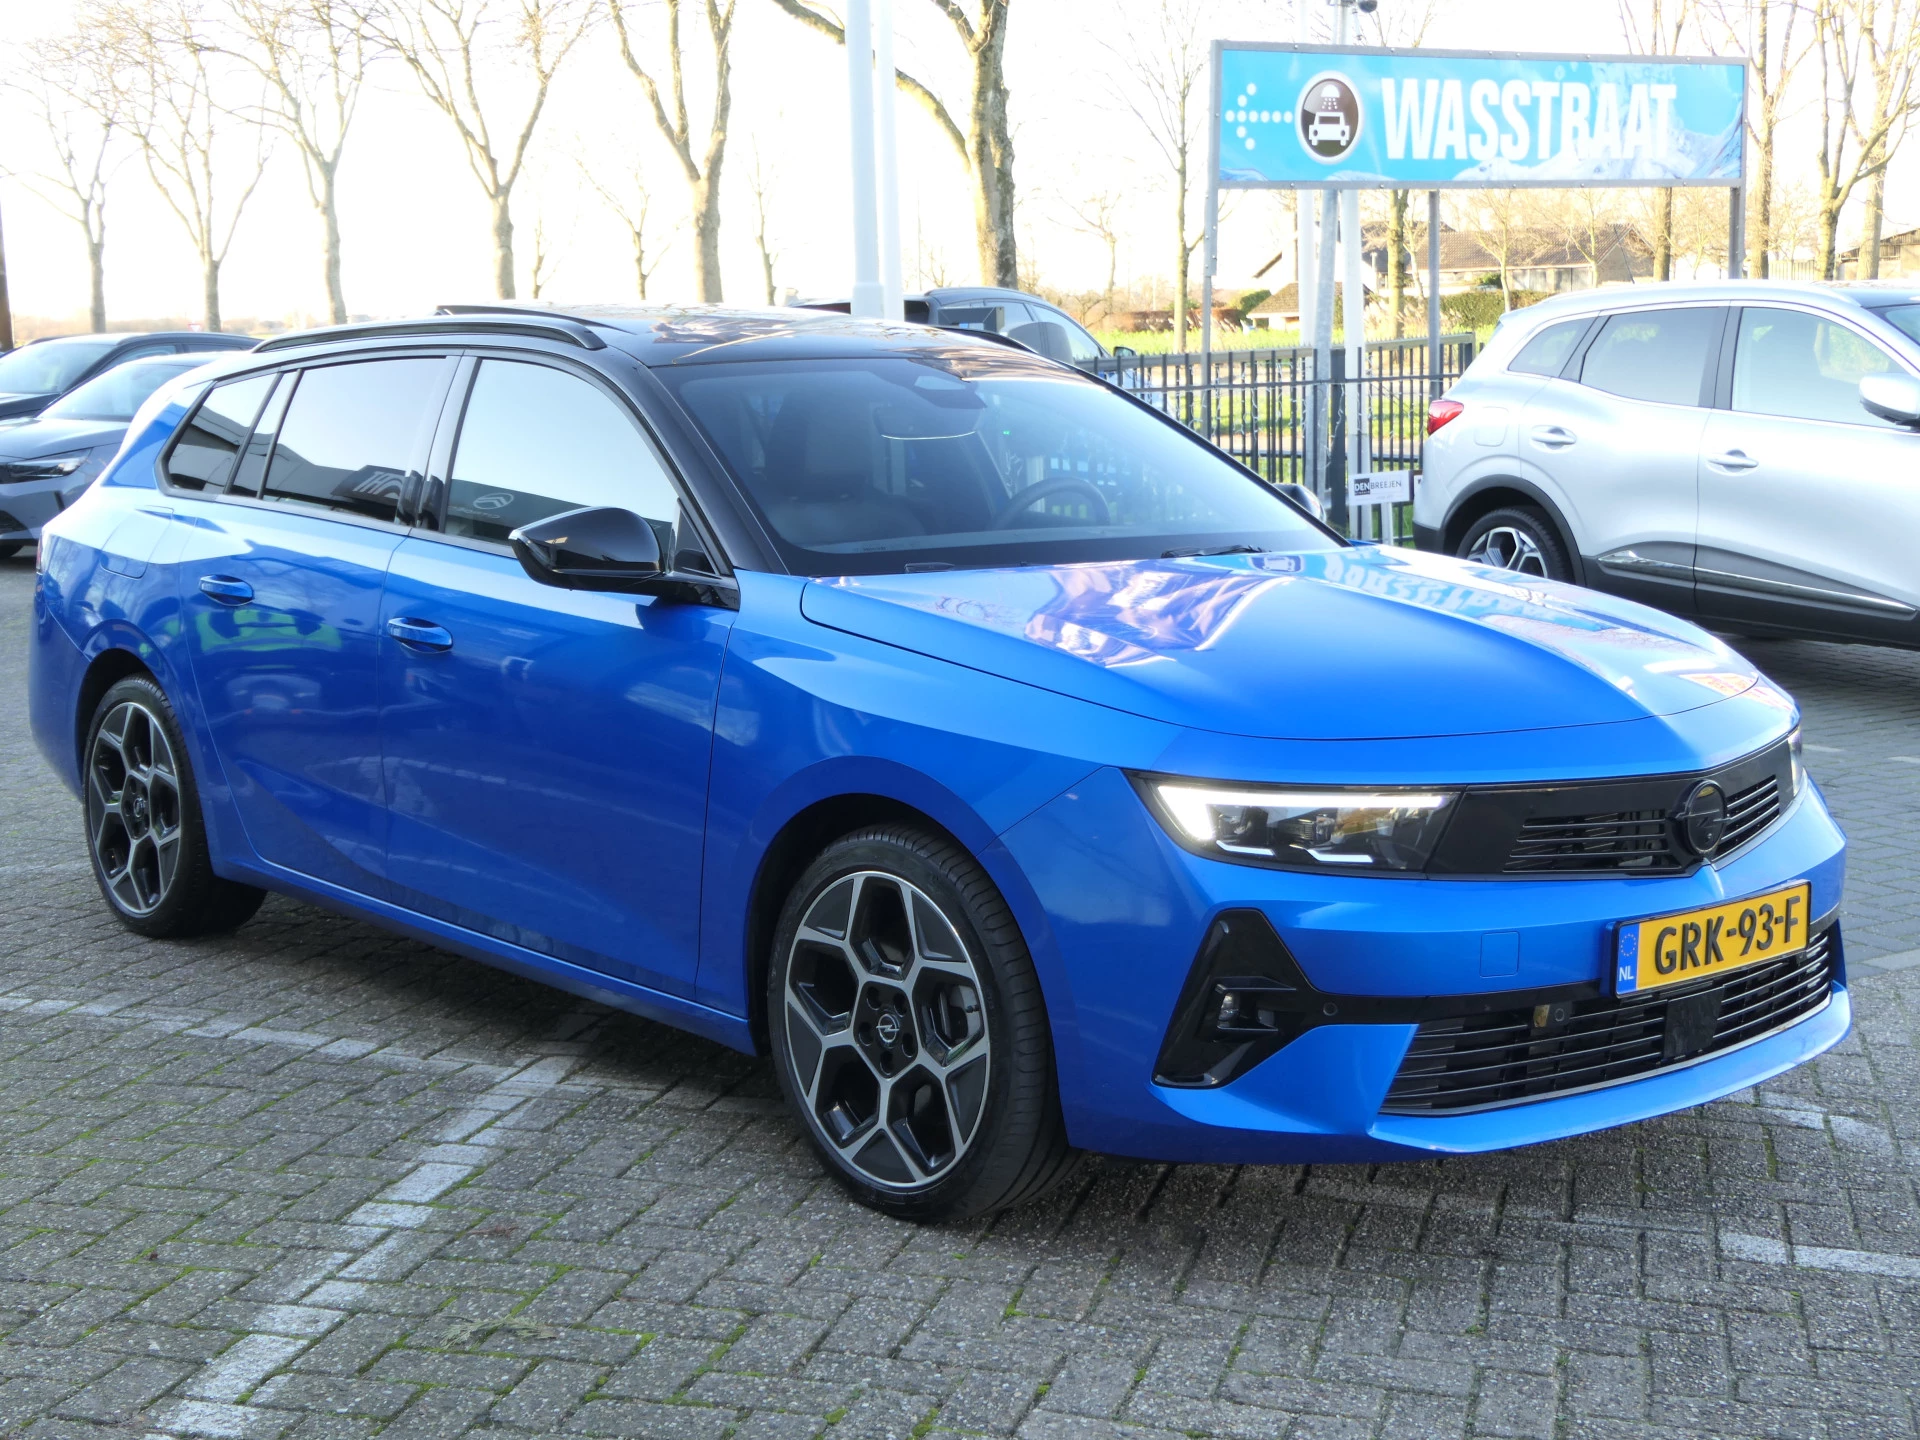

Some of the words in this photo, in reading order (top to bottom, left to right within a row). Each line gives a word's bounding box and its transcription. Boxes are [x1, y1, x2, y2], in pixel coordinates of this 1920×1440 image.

[1381, 78, 1677, 161] WASSTRAAT
[1618, 965, 1634, 981] NL
[1655, 896, 1801, 975] GRK-93-F
